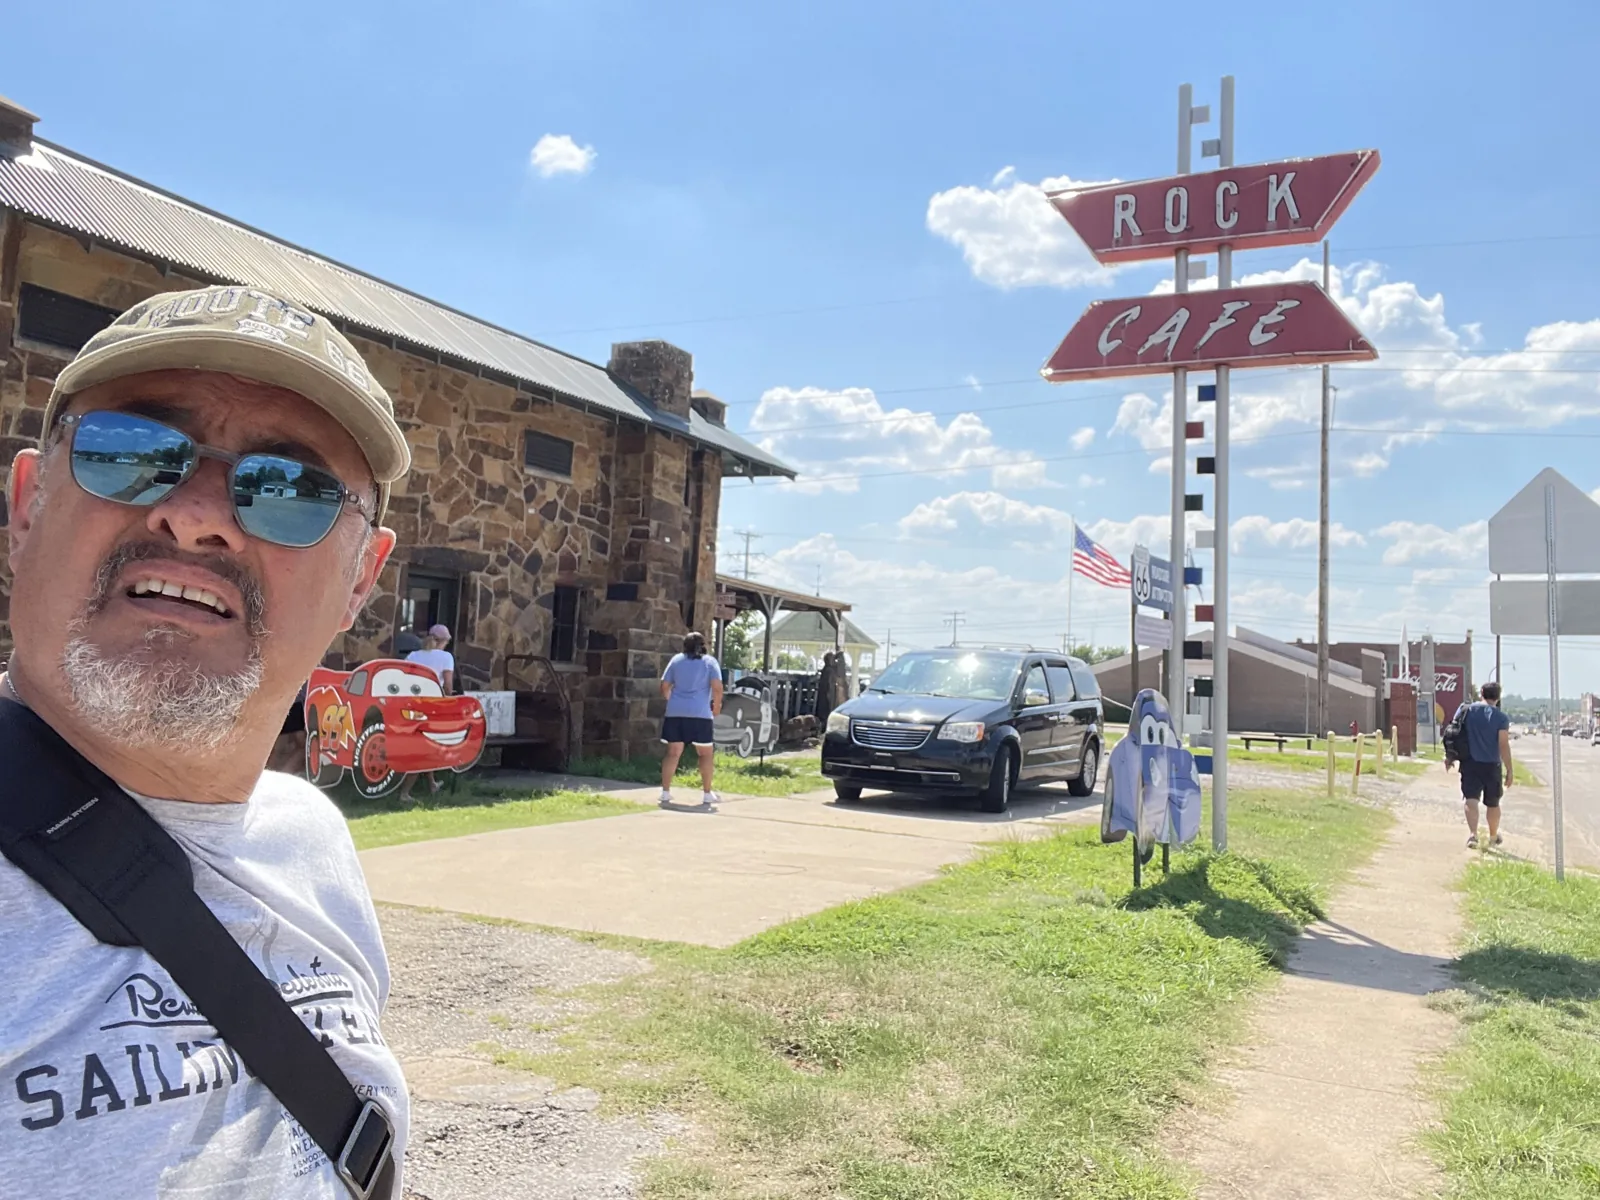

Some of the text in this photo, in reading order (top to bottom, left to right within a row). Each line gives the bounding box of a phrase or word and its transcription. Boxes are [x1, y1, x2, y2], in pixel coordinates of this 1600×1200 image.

[1113, 172, 1300, 239] ROCK
[149, 288, 316, 340] ROUTE
[1097, 299, 1301, 361] CAFE
[325, 338, 372, 393] 66
[1135, 565, 1148, 598] 66
[319, 705, 348, 751] 95
[15, 1006, 387, 1132] SAILIN TEA
